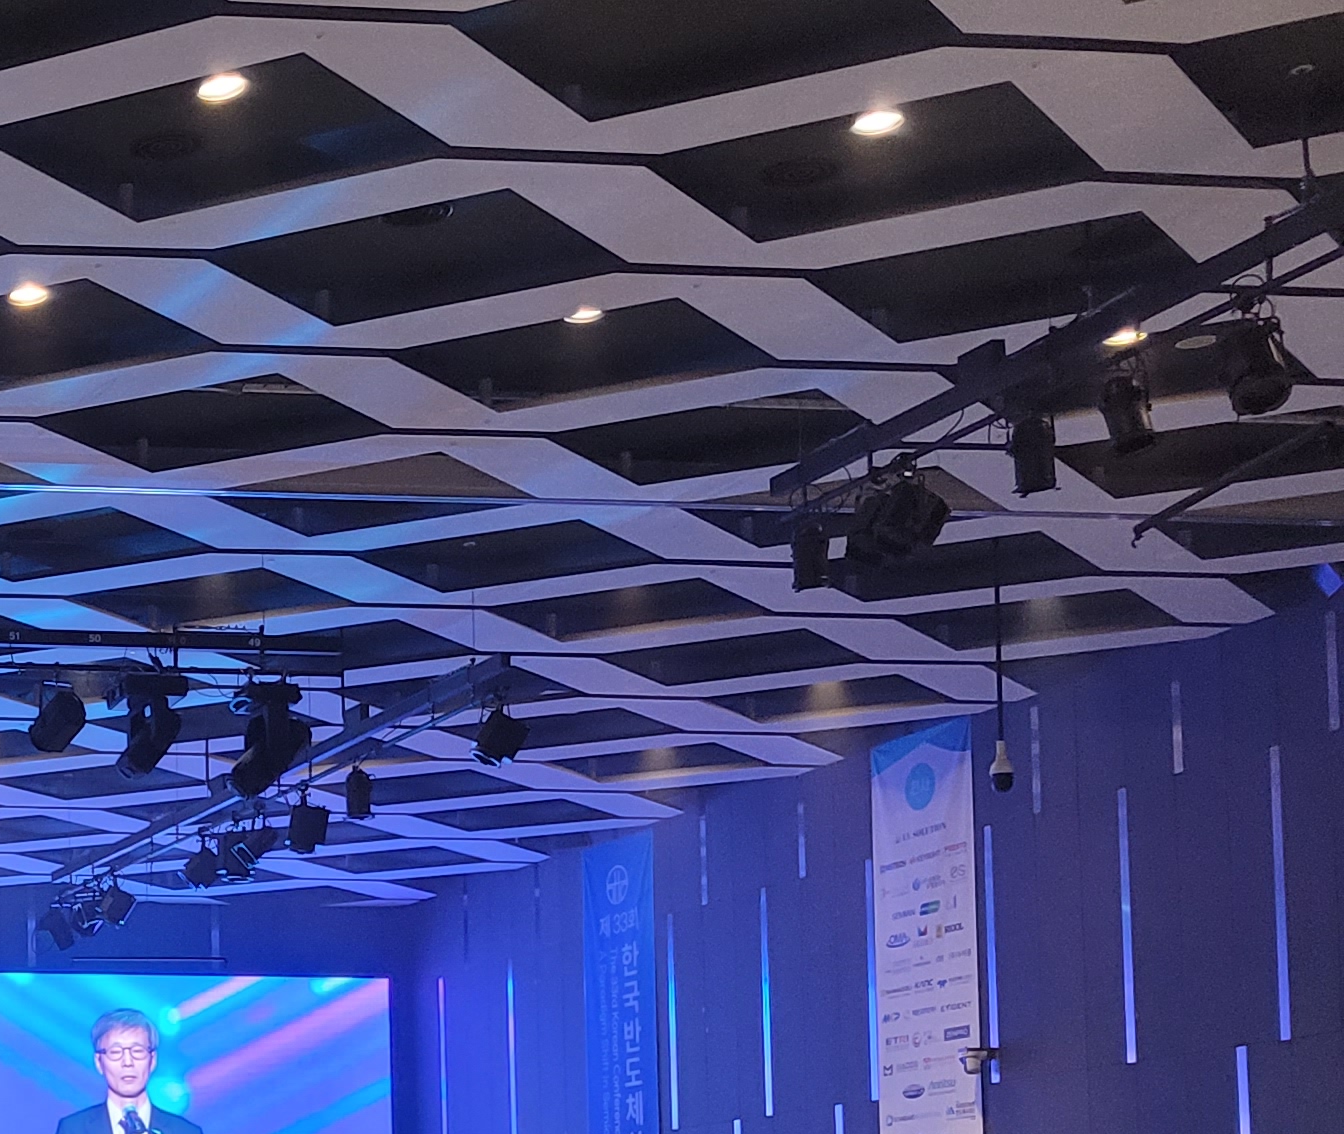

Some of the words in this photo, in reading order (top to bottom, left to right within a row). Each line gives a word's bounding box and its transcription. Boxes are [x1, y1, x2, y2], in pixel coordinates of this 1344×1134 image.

[89, 634, 102, 643] 50
[248, 638, 262, 648] 49
[598, 913, 611, 938] 제
[612, 905, 639, 935] 33회
